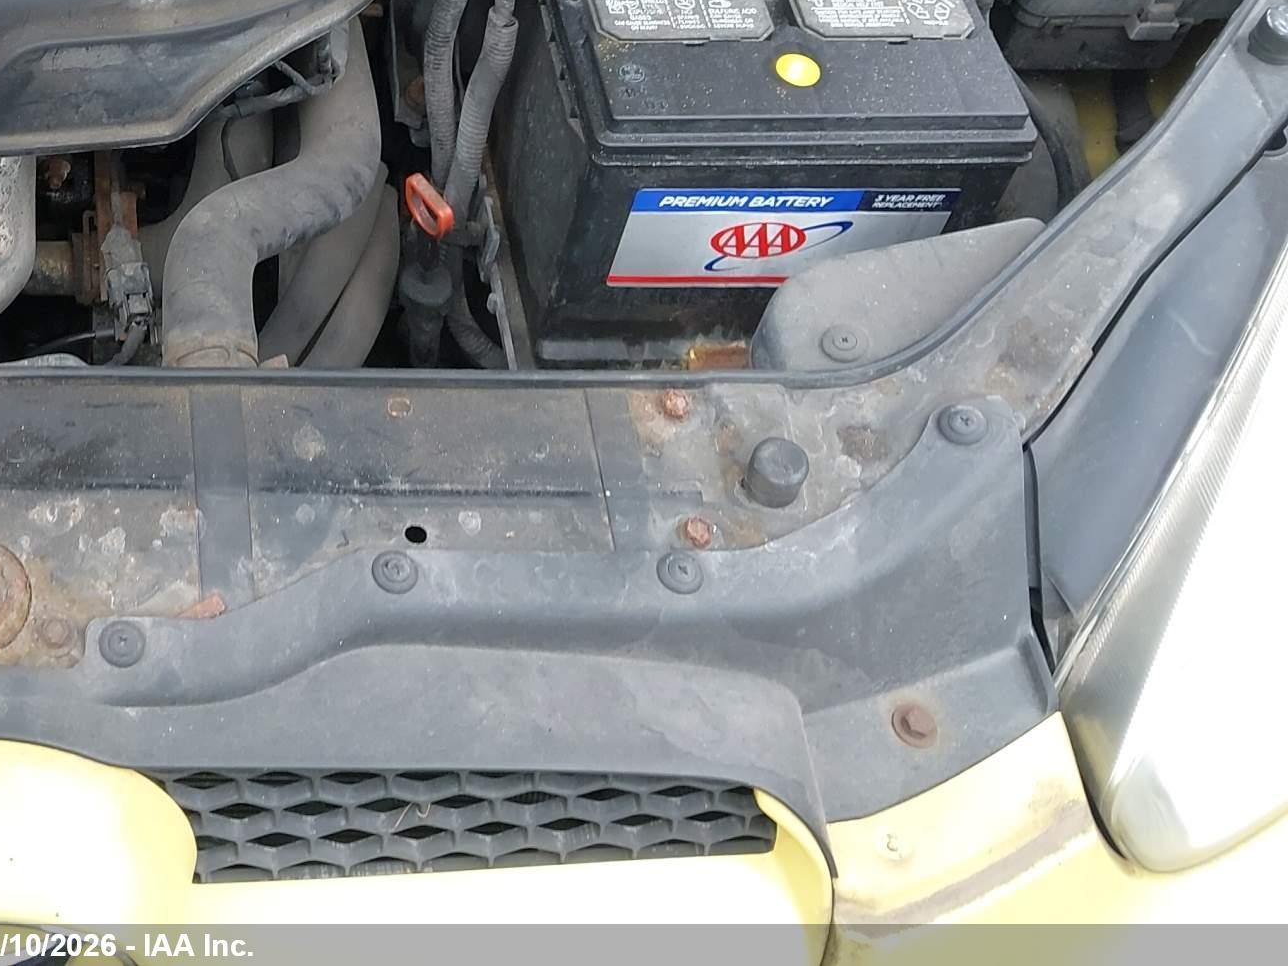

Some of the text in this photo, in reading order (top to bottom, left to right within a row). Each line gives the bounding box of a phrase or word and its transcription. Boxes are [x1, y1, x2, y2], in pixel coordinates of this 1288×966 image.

[659, 194, 834, 208] PREMIUM BATTERY
[885, 194, 915, 202] YEAR
[719, 222, 795, 258] AAA
